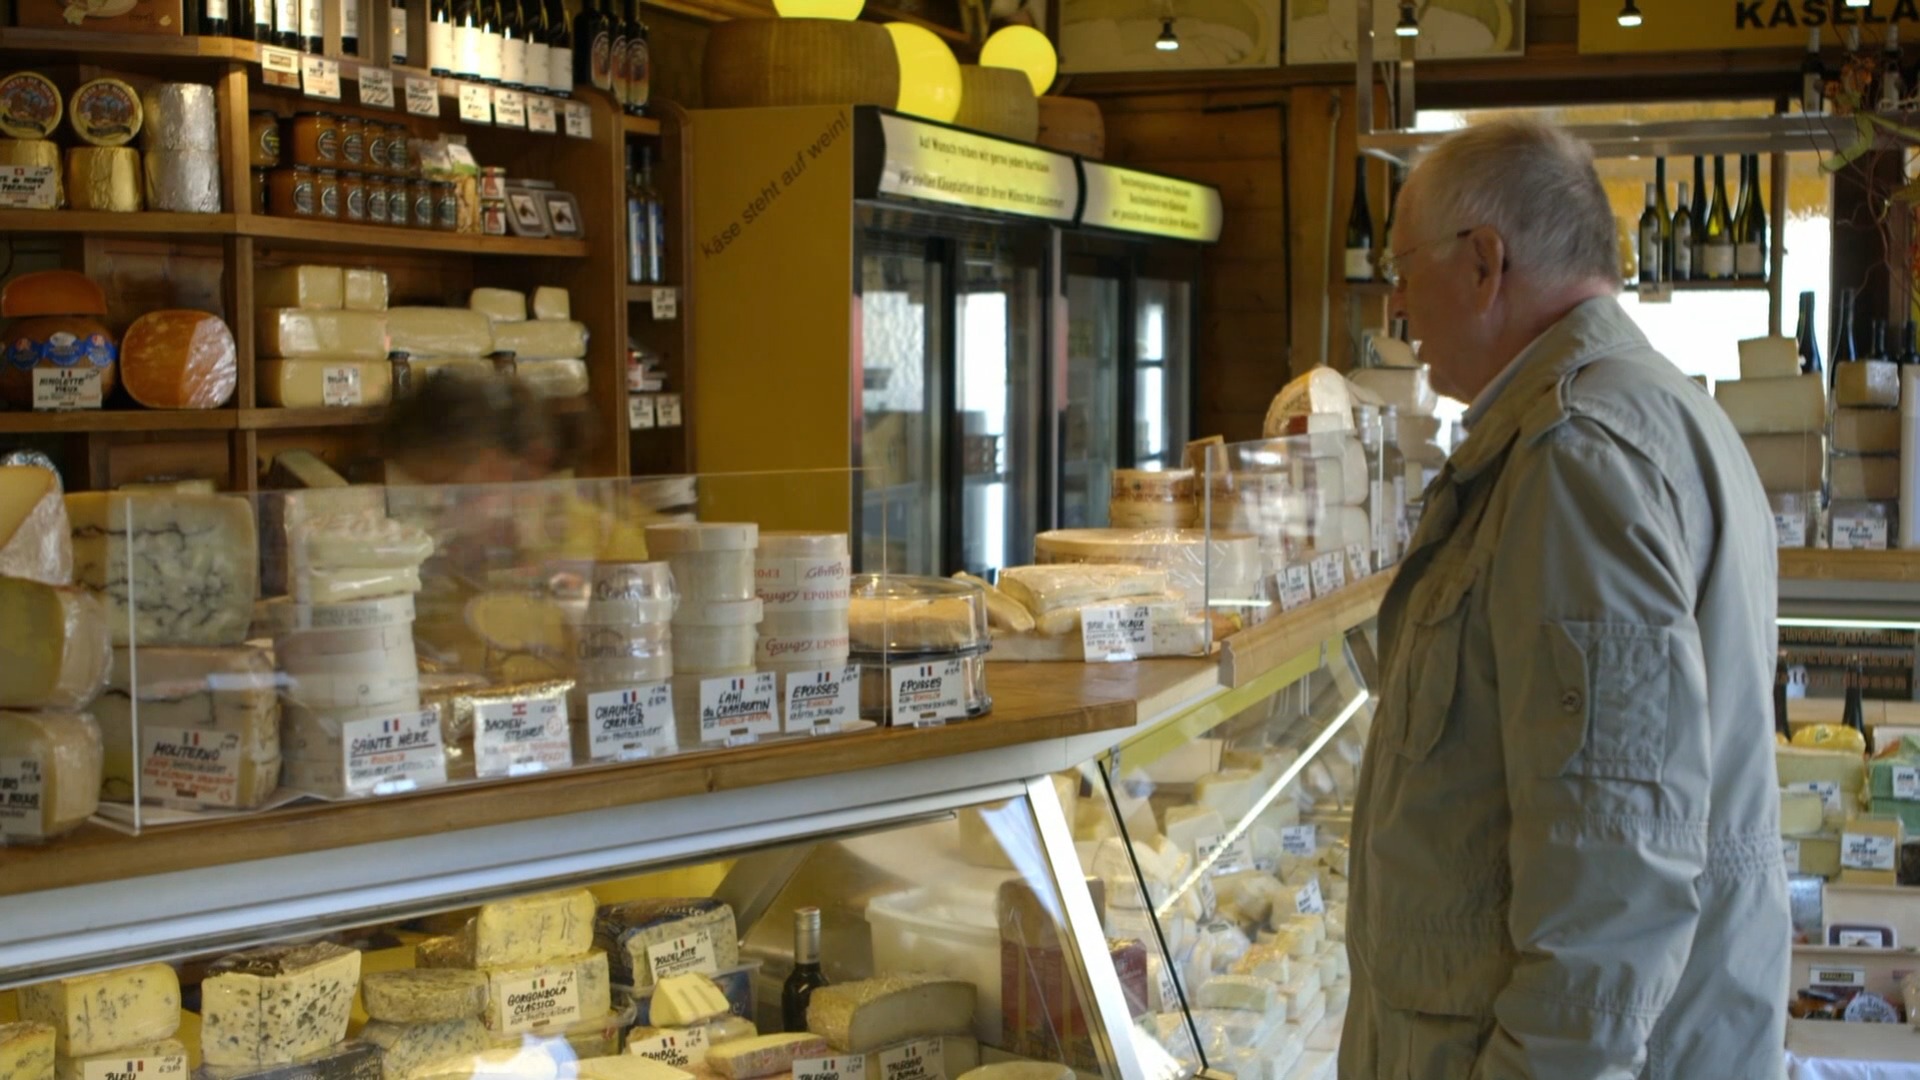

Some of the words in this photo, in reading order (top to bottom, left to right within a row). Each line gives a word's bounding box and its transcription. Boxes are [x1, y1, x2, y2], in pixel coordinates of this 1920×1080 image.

[701, 222, 742, 259] käse
[742, 180, 782, 224] steht
[781, 150, 807, 187] auf
[807, 110, 851, 159] wein!
[792, 682, 841, 699] EPOISSES
[595, 702, 643, 720] CHAUMES
[154, 741, 221, 762] MOLITERNO
[350, 733, 393, 756] SAINTE
[514, 999, 556, 1016] CLASSICO
